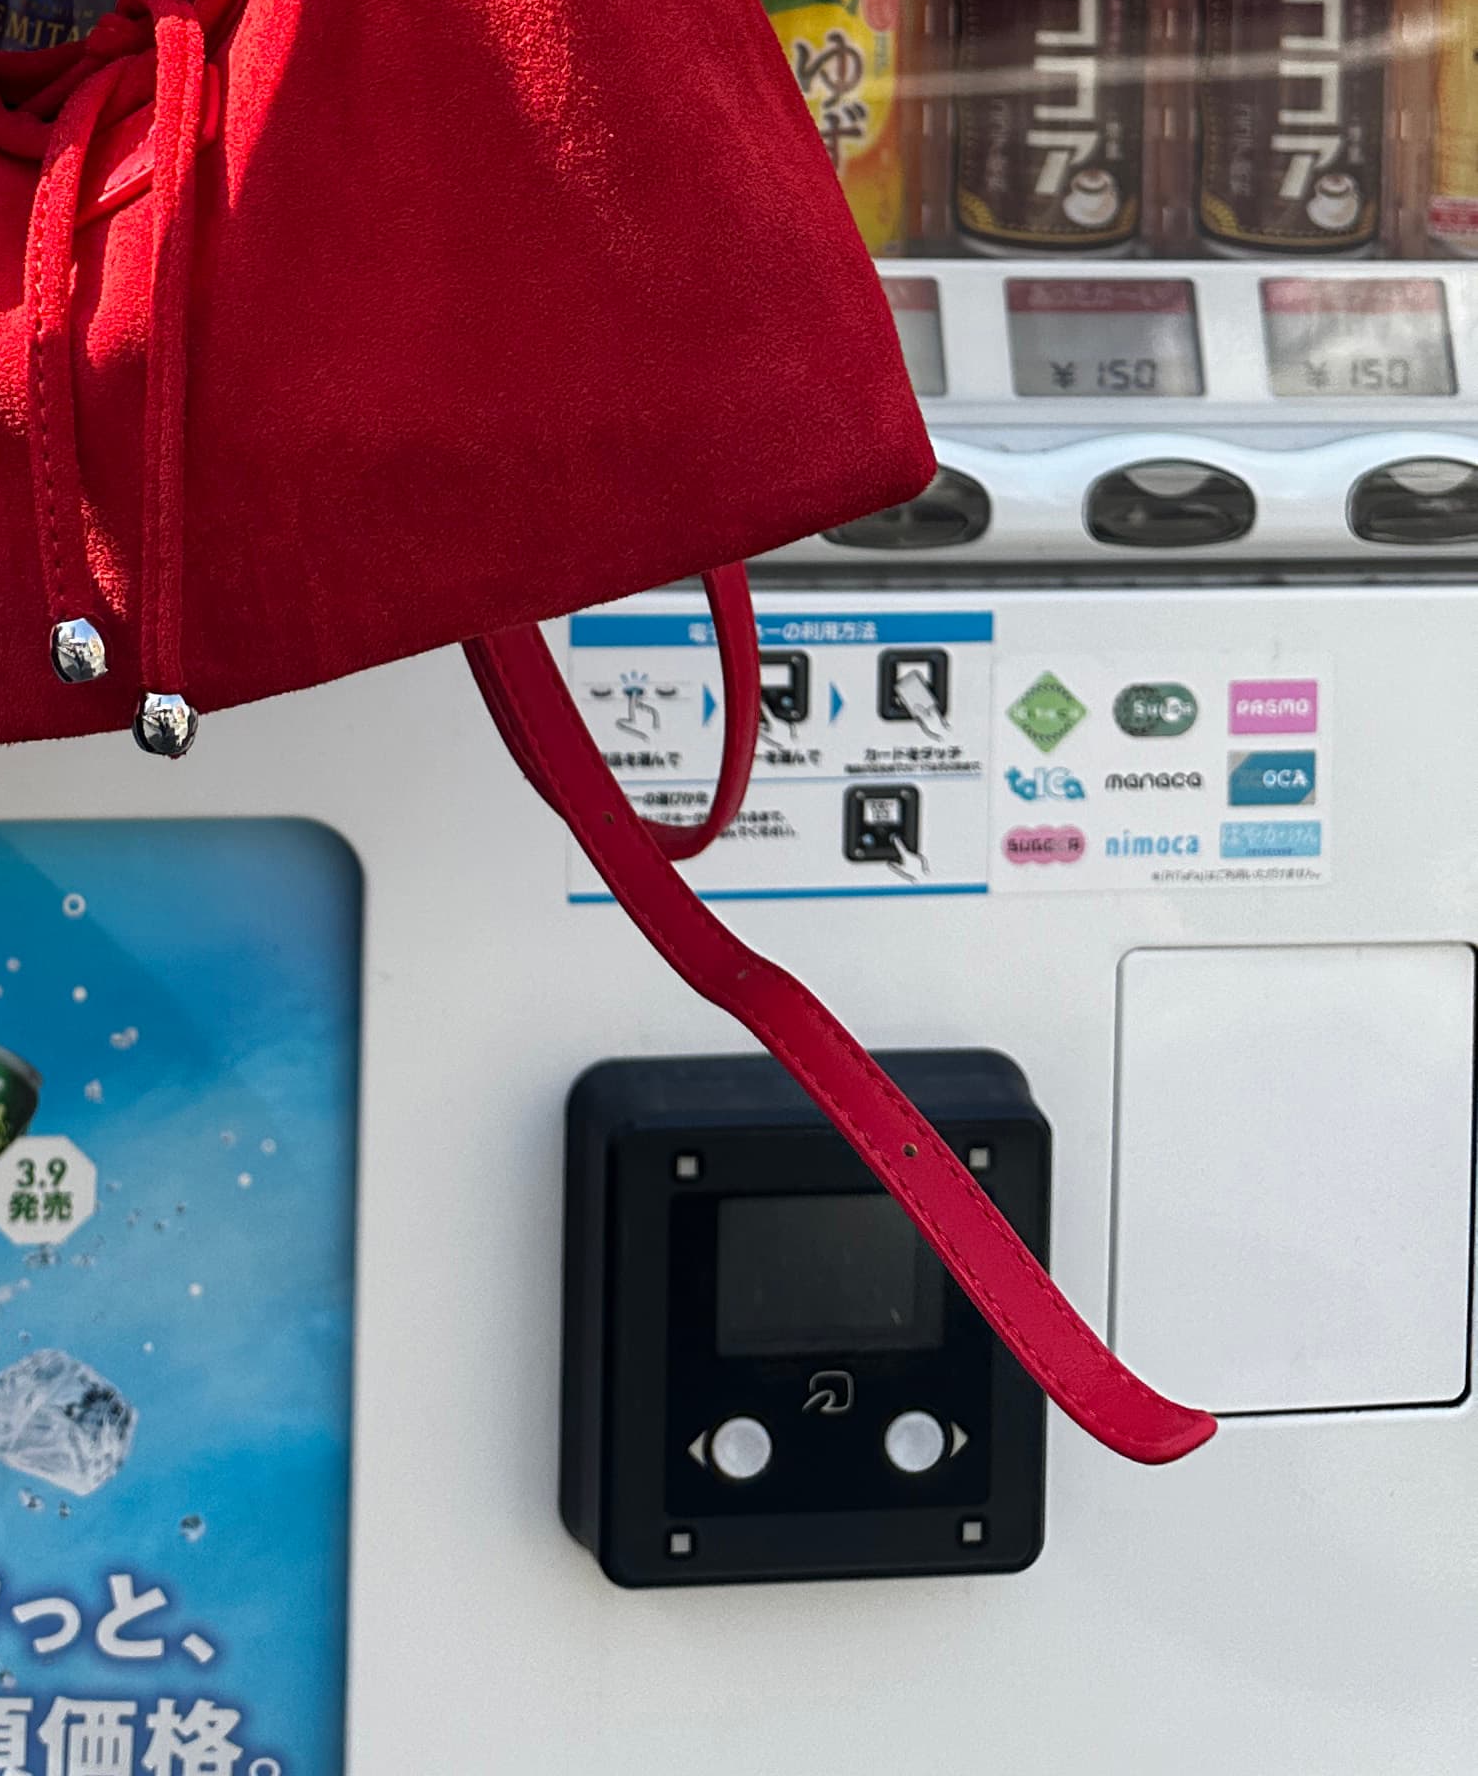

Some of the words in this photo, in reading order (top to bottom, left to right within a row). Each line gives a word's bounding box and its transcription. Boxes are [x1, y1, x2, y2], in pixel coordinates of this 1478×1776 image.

[1235, 699, 1311, 717] PASMO
[1105, 771, 1204, 791] manaca
[1105, 830, 1201, 858] nimoca
[17, 1158, 67, 1189] 3.9
[8, 1190, 74, 1222] 発売
